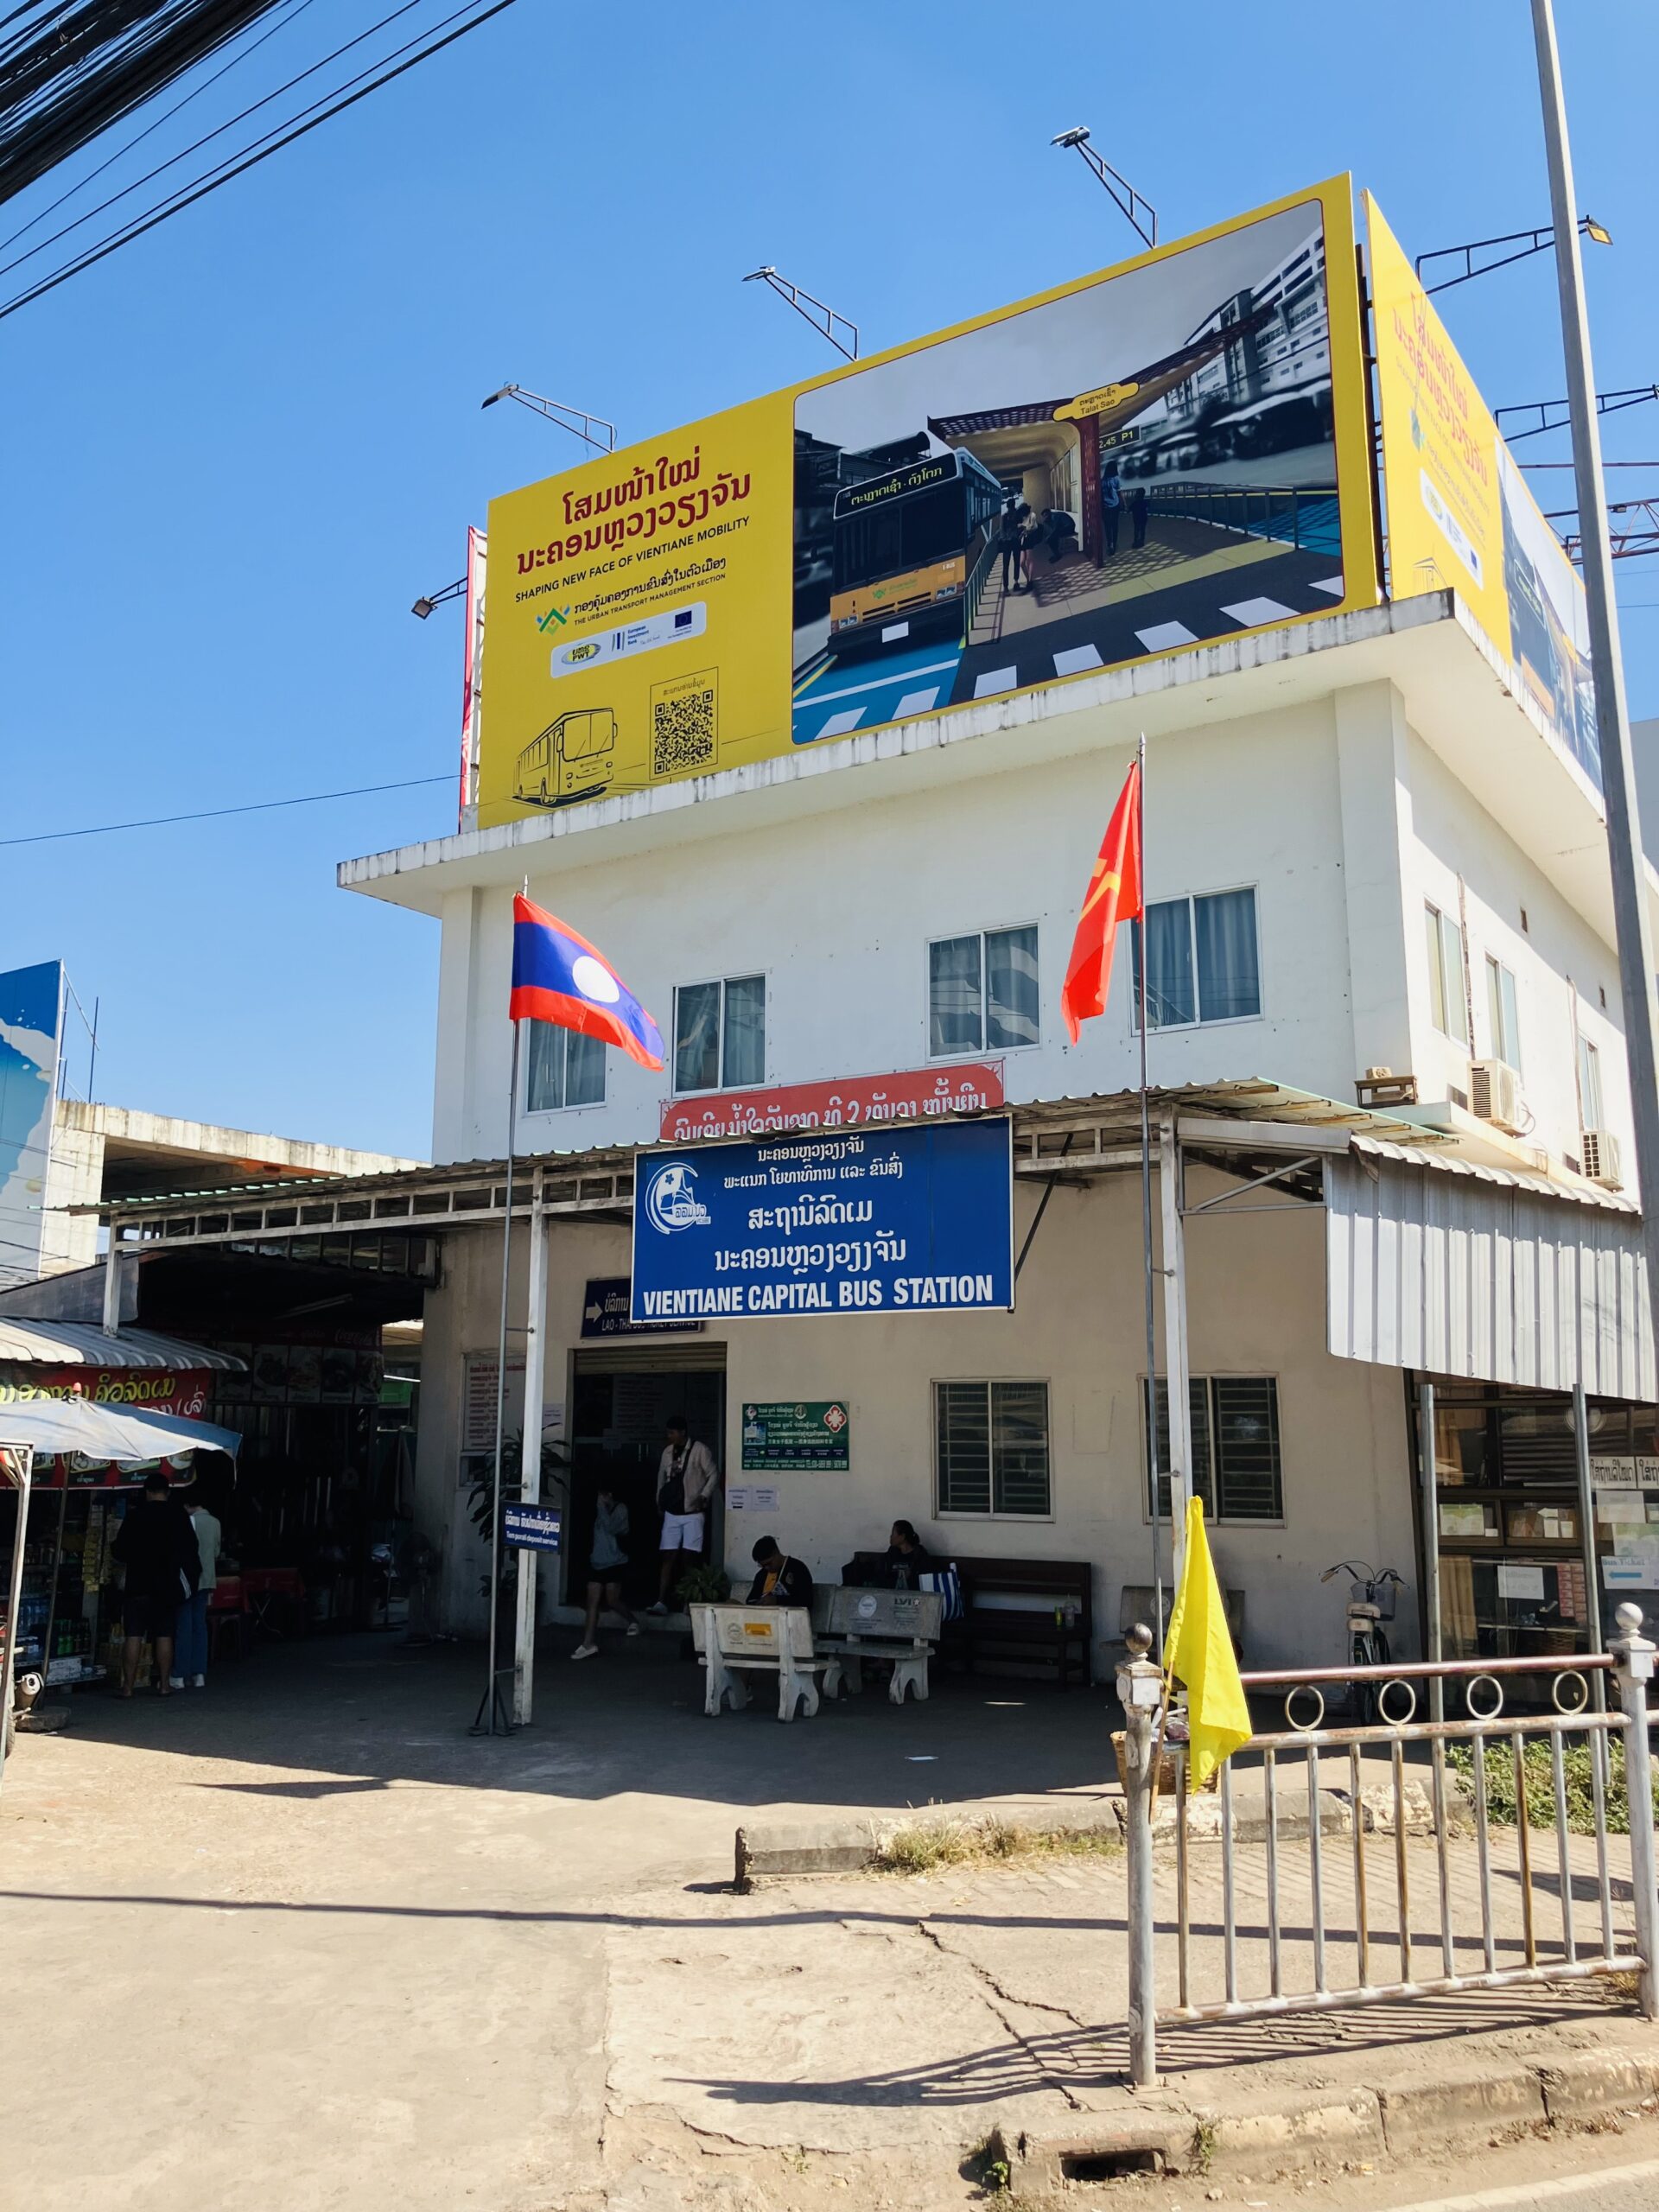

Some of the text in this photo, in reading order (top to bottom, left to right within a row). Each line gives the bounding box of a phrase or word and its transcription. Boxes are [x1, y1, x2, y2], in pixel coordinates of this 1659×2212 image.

[1080, 398, 1116, 415] Talat Sao
[1122, 430, 1134, 442] P1
[563, 446, 701, 524] ໂສມໜ້າໃໝ່
[518, 473, 751, 575] ນະຄອນຫຼວງວຽງຈັນ
[515, 516, 750, 602] SHAPING NEW FACE OF VIENTIANE MOBILITY
[574, 573, 726, 626] THE URBAN TRANSPORT MANAGEMENT SECTION
[572, 652, 588, 662] PWT
[848, 1100, 860, 1122] 2
[757, 1136, 865, 1165] ນະຄອນຫຼວງວຽງຈັນ
[723, 1152, 903, 1189] ພະແນກ ໂຍທາທິການ ແລະ ຂົນສົ່ງ
[747, 1194, 873, 1235] ສະຖານີລົດເມ
[715, 1230, 906, 1275] ນະຄອນຫຼວງວຽງຈັນ
[643, 1274, 993, 1315] VIENTIANE CAPITAL BUS STATION
[601, 1319, 614, 1332] LAO
